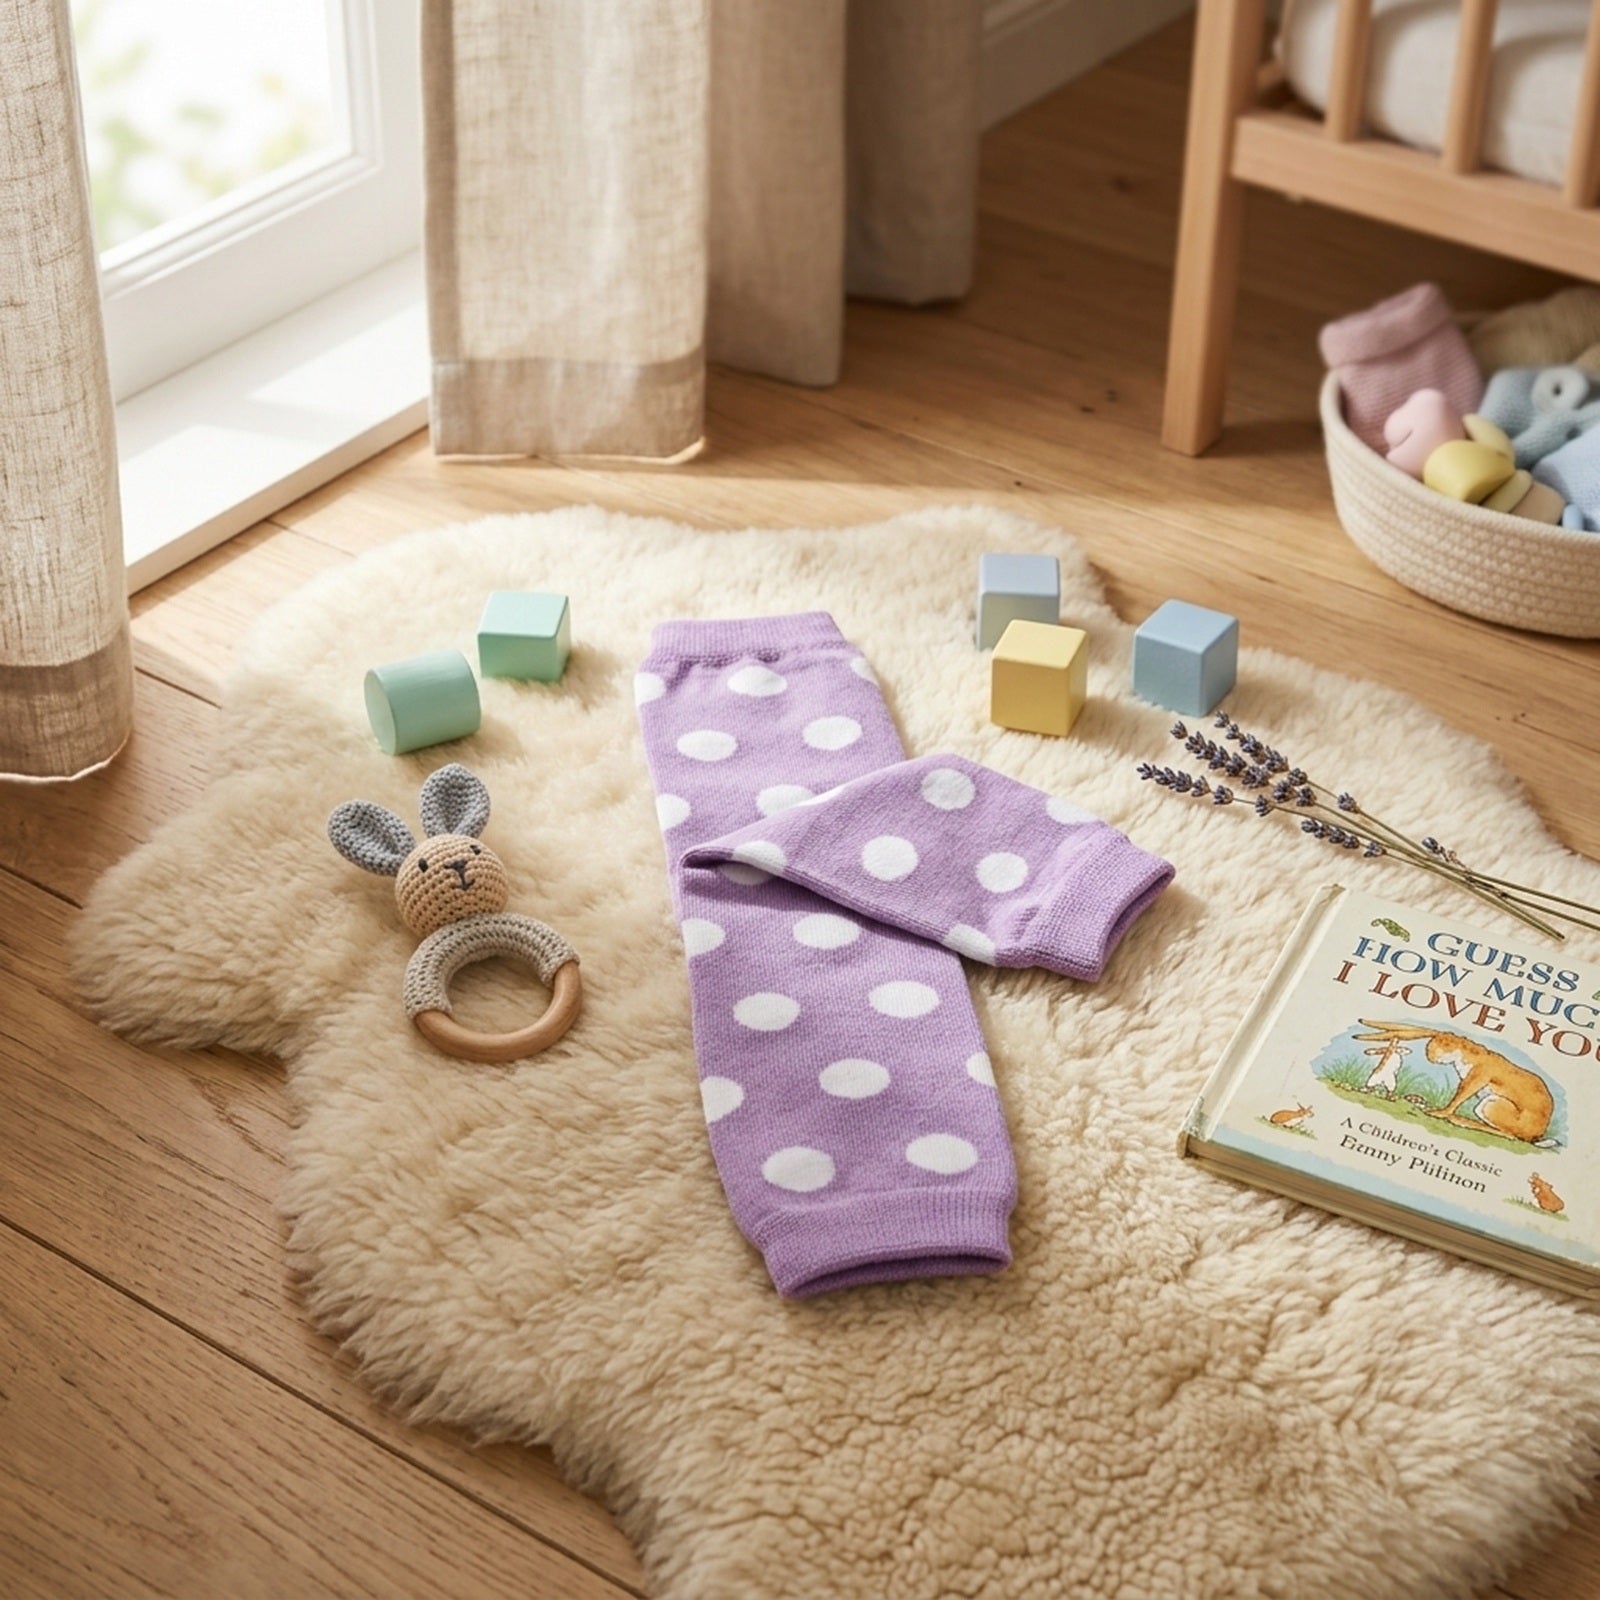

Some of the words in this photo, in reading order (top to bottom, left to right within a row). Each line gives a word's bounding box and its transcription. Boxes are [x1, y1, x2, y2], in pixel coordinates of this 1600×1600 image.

[1352, 936, 1474, 988] HOW
[1427, 932, 1580, 992] GUESS
[1333, 960, 1358, 985] I
[1368, 971, 1506, 1033] LOVE
[1525, 1016, 1600, 1062] YO
[1339, 1117, 1353, 1129] A
[1444, 1149, 1503, 1178] Classic
